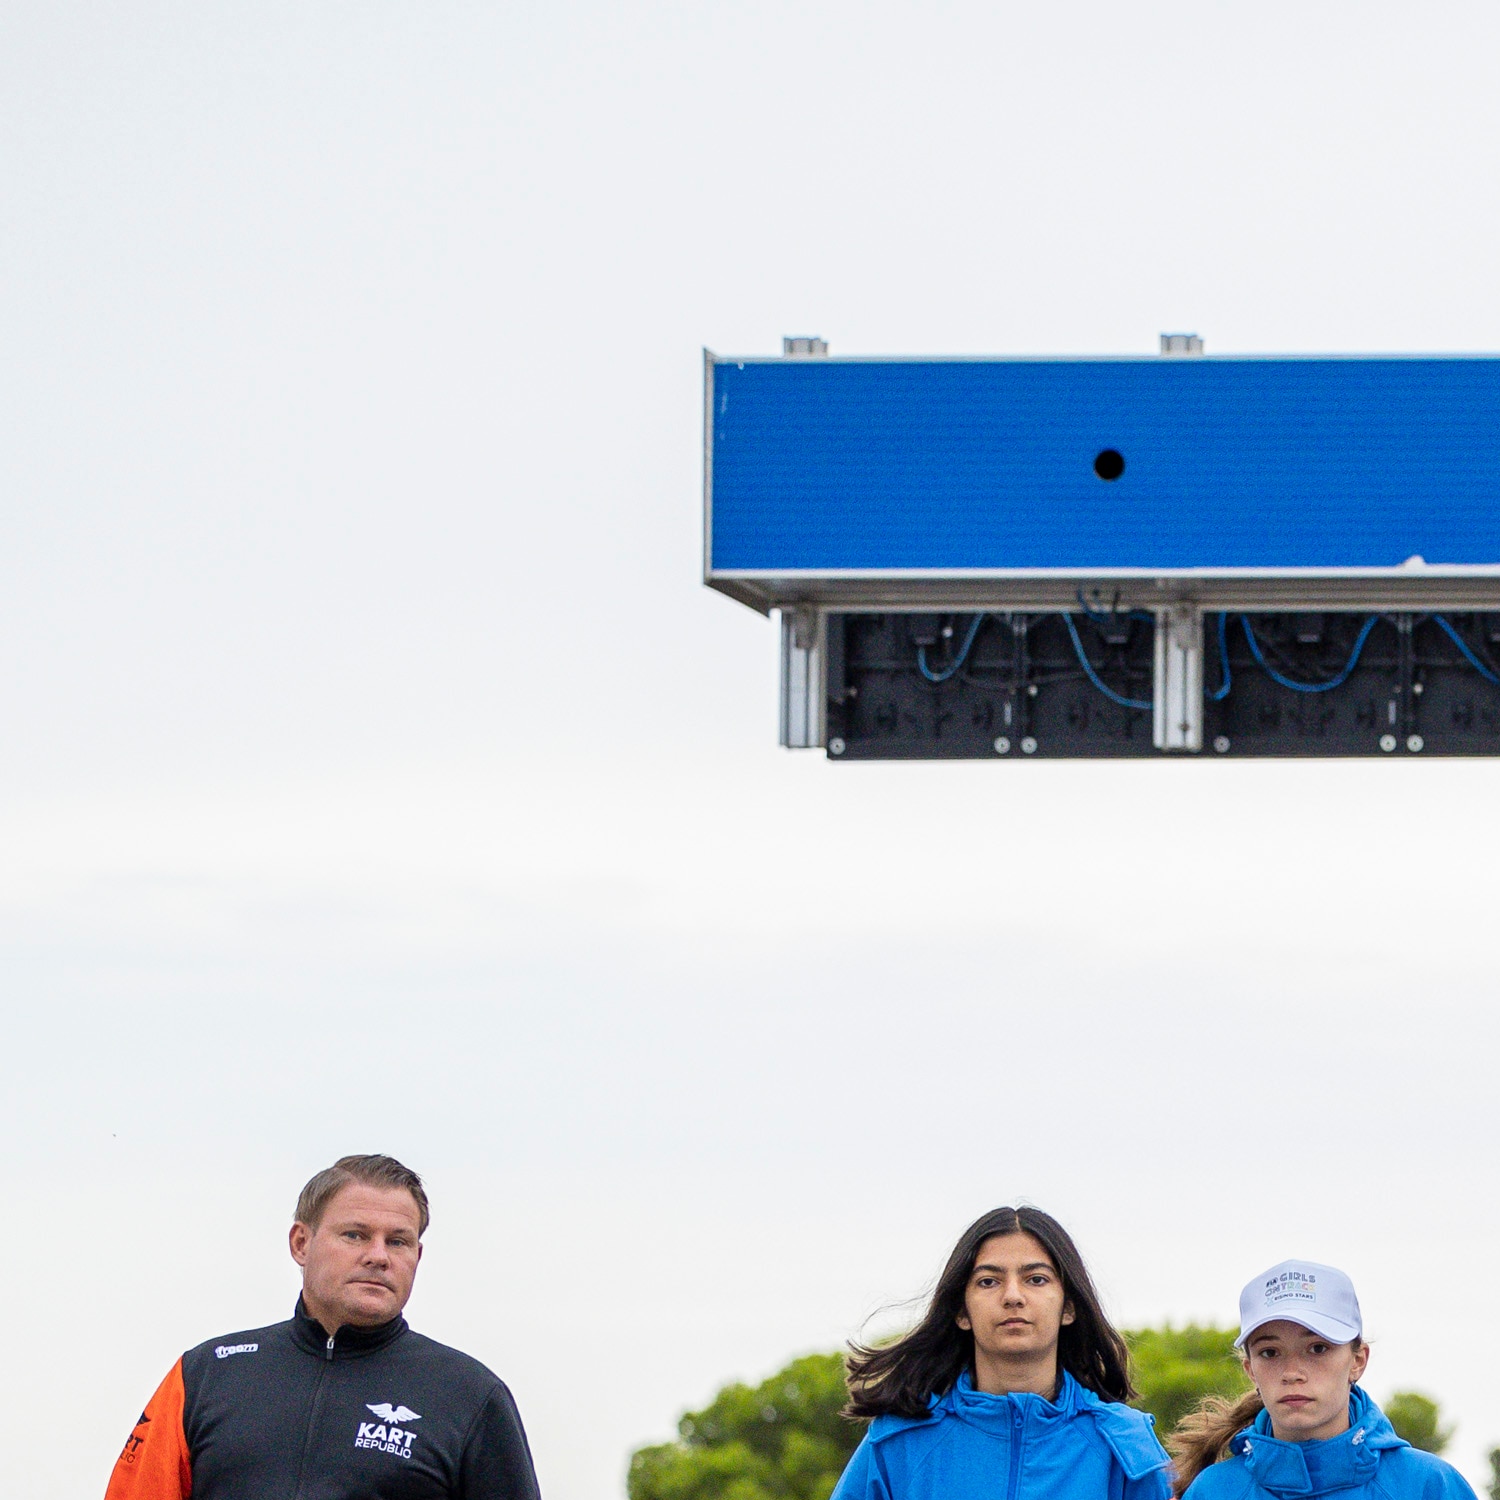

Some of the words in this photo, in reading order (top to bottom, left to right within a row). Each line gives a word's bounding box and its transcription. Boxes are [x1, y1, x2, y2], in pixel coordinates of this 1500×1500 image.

[1280, 1272, 1316, 1283] GIRLS
[357, 1422, 417, 1448] KART
[355, 1438, 412, 1459] REPUBLIC
